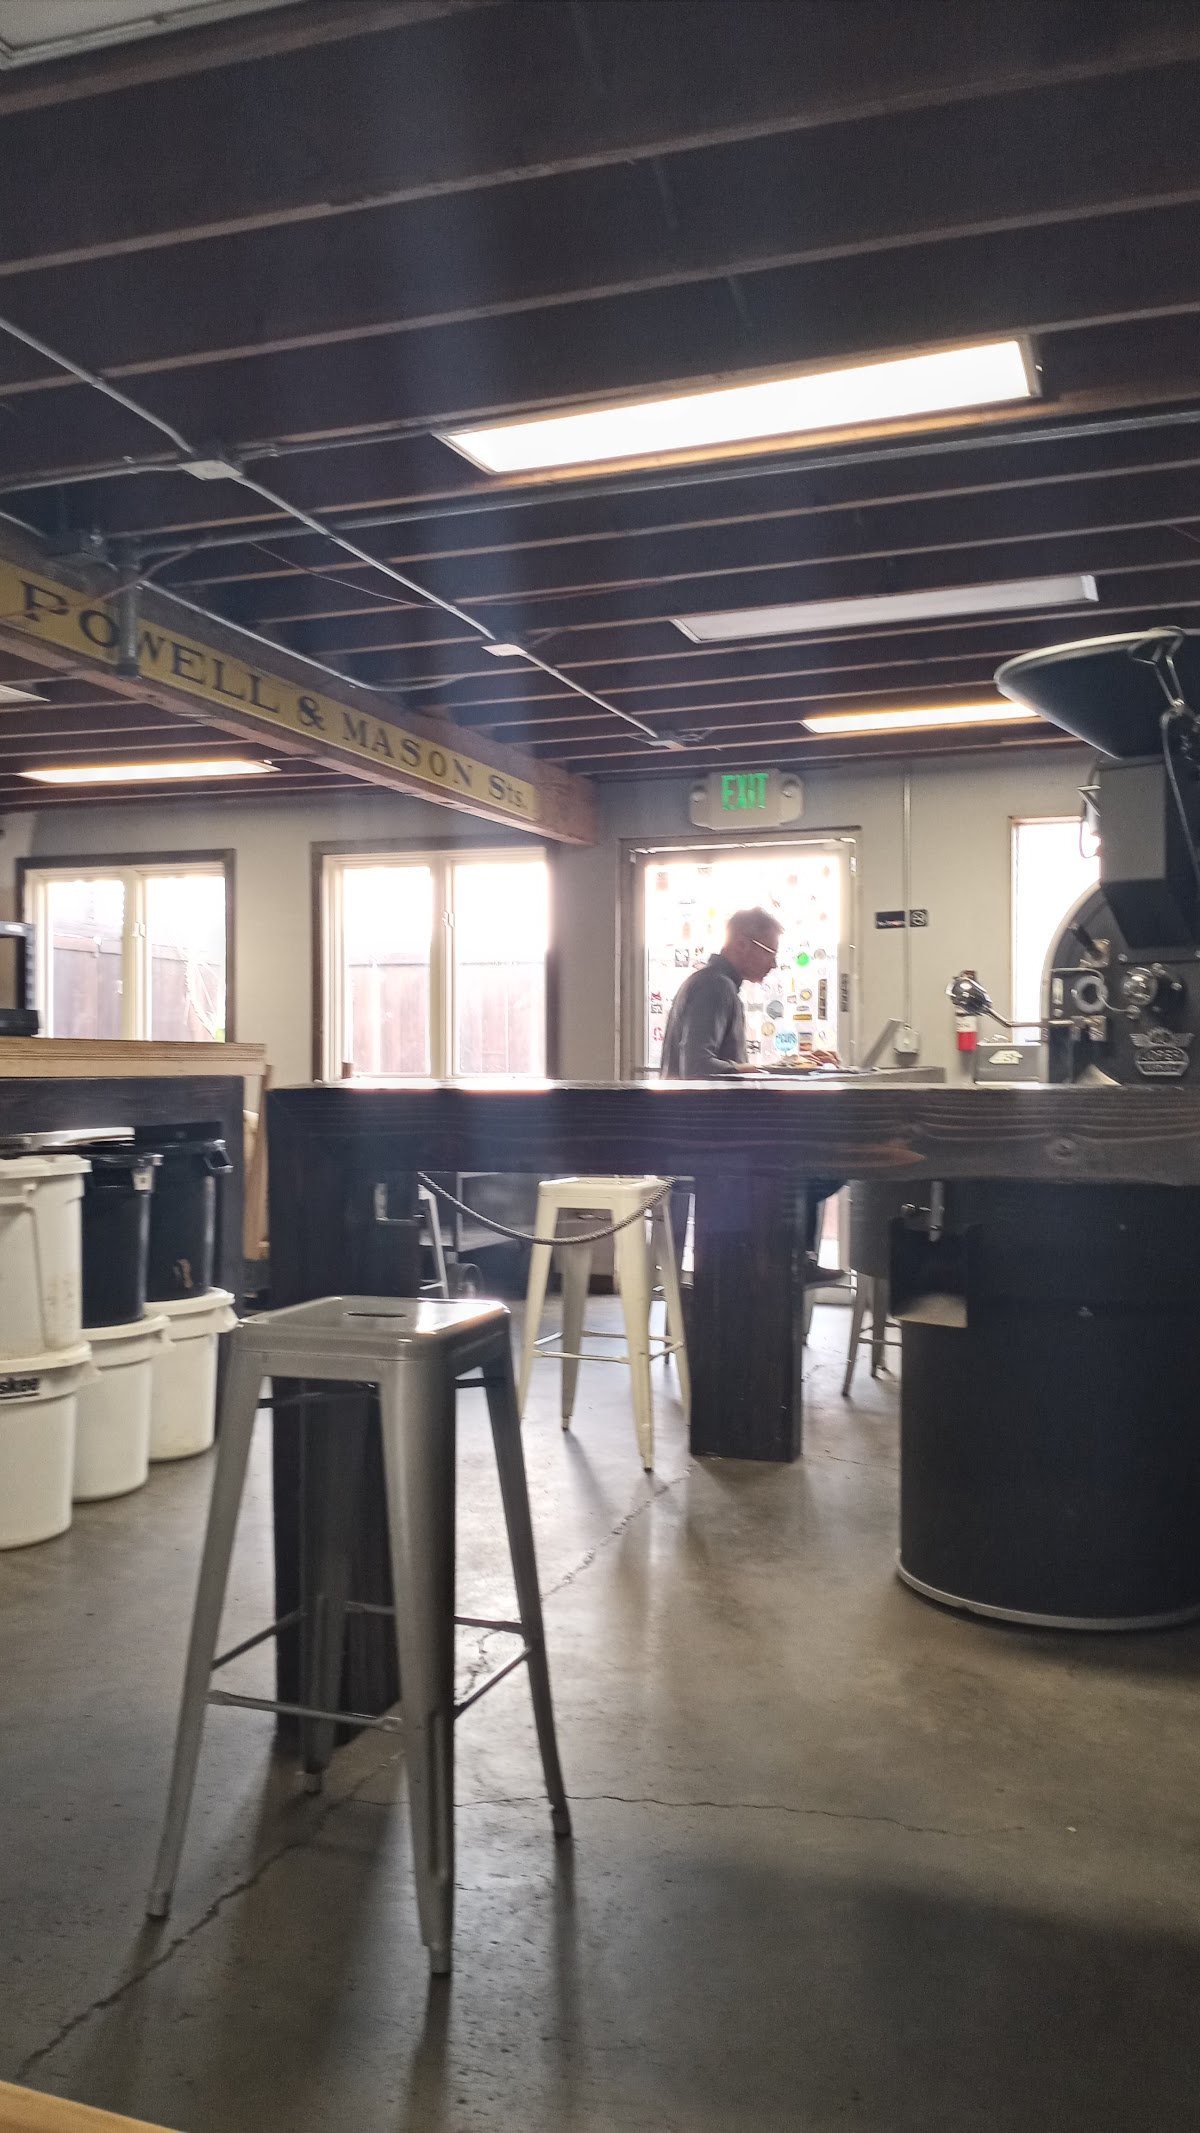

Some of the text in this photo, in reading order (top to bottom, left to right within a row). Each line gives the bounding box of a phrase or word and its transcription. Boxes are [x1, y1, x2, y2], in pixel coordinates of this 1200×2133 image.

[297, 695, 326, 731] &
[340, 712, 472, 787] MASON
[721, 773, 768, 811] EXIT
